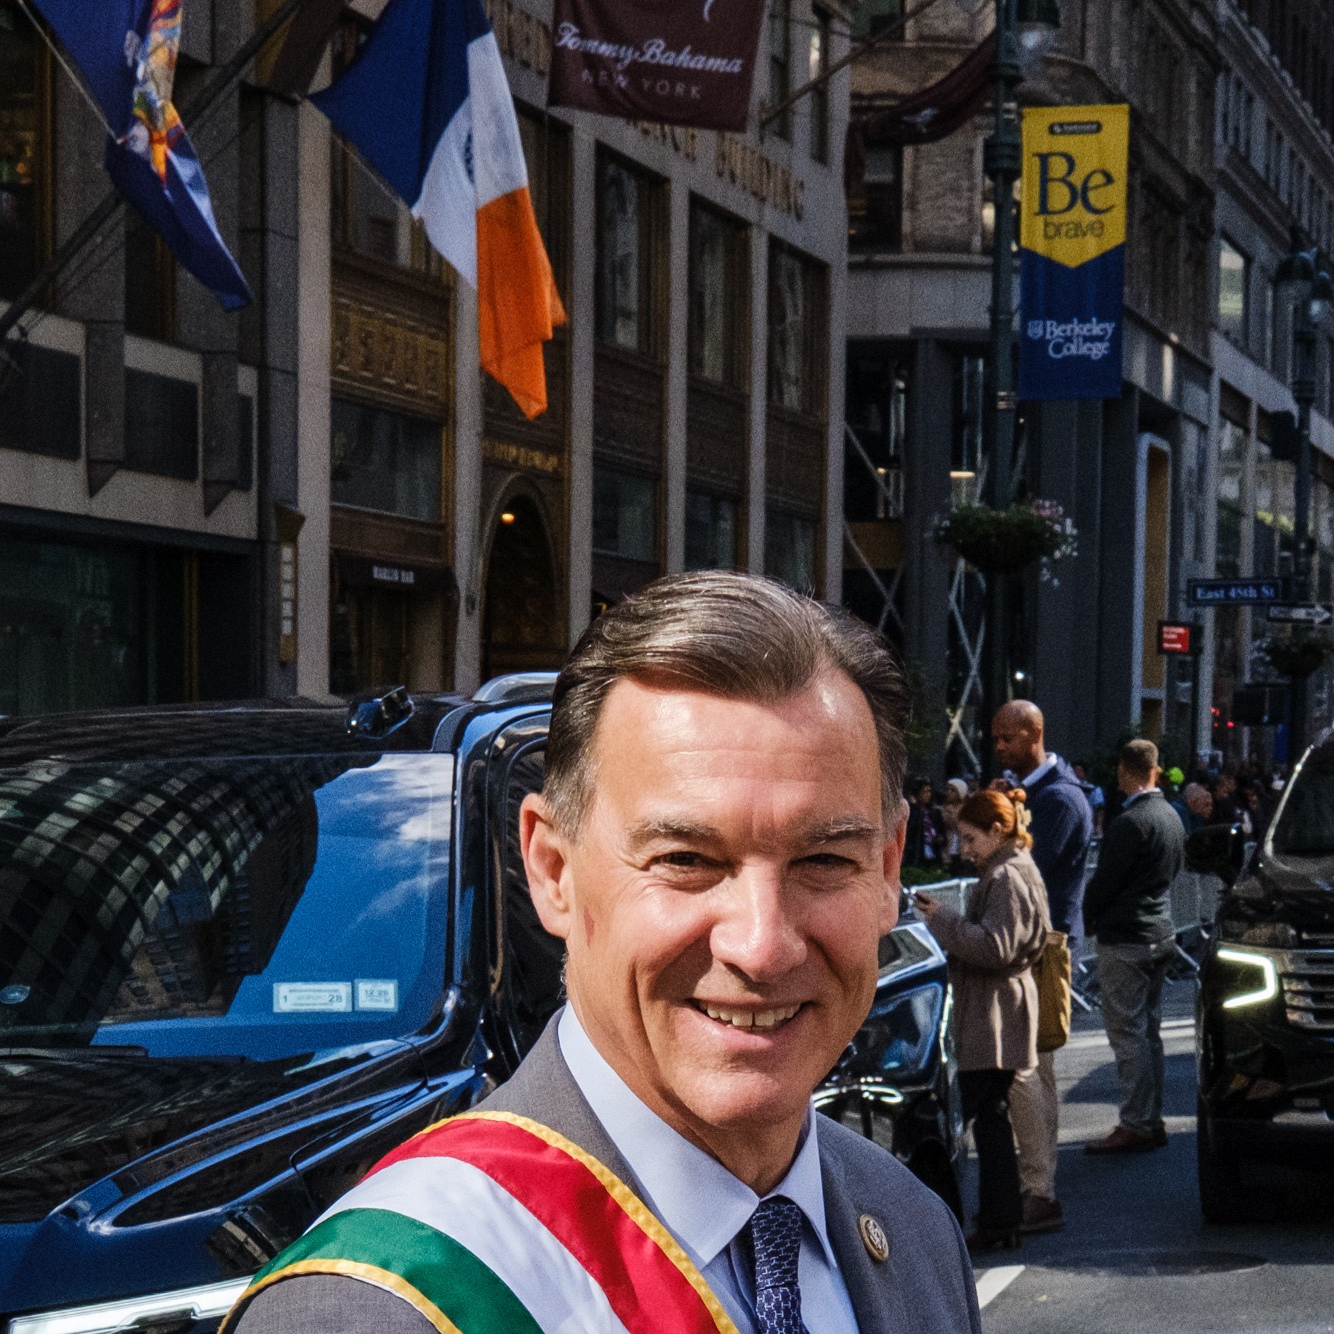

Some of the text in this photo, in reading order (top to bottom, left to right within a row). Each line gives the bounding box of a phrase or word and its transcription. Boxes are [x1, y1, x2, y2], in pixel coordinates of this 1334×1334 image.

[556, 21, 635, 70] Tommy
[635, 38, 743, 73] Bahama
[641, 78, 701, 99] YORK
[1032, 152, 1115, 216] Be
[1044, 219, 1104, 239] brave
[1045, 318, 1115, 341] Berkeley
[1048, 338, 1110, 360] College
[1196, 587, 1225, 599] East
